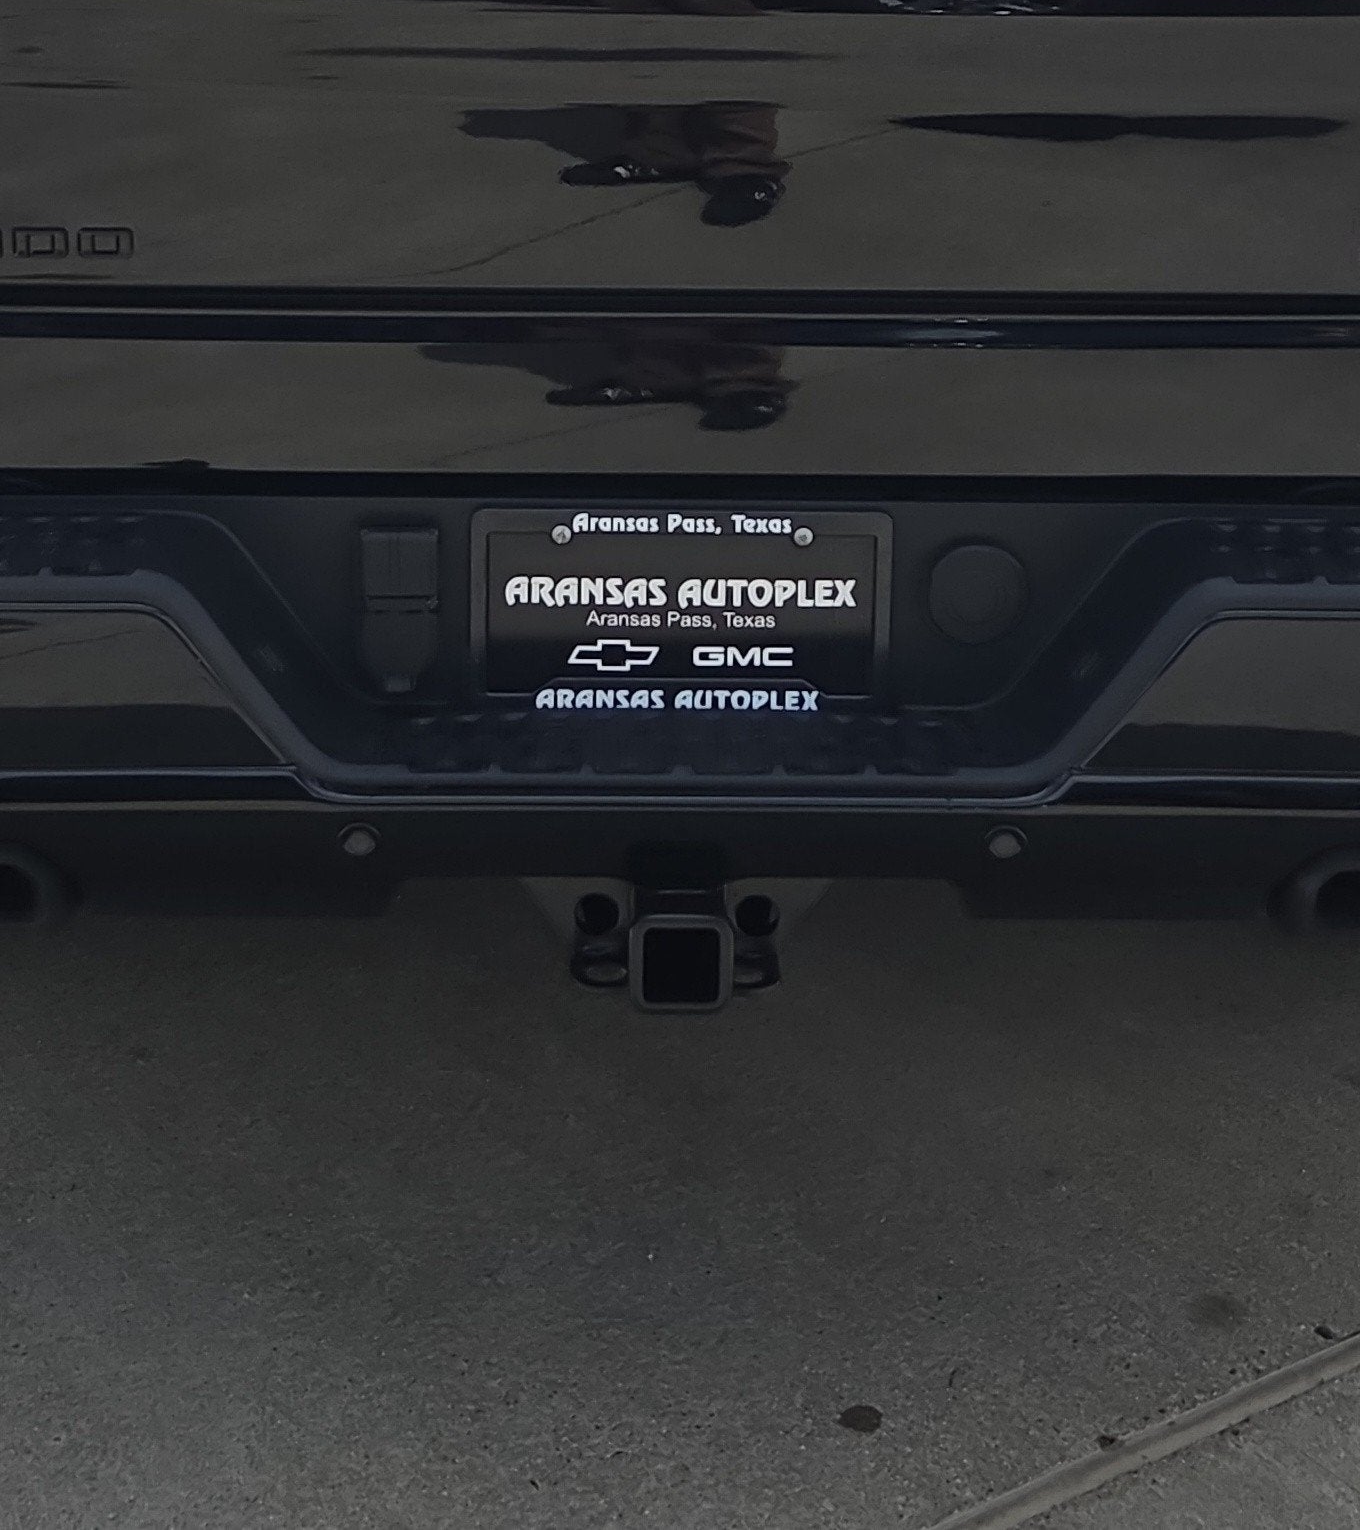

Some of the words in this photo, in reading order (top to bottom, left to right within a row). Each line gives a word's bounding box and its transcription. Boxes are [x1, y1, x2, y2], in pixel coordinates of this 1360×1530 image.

[572, 512, 659, 534] Aransas
[667, 513, 722, 535] Pass,
[730, 514, 792, 534] Texas
[504, 575, 668, 609] ARANSAS
[677, 578, 858, 610] AUTOPLEX
[585, 610, 662, 628] Aransas
[666, 611, 718, 630] Pass,
[723, 611, 776, 629] Texas
[692, 646, 794, 667] GMC
[535, 687, 666, 710] ARANSAS
[674, 688, 820, 711] AUTOPLEX
